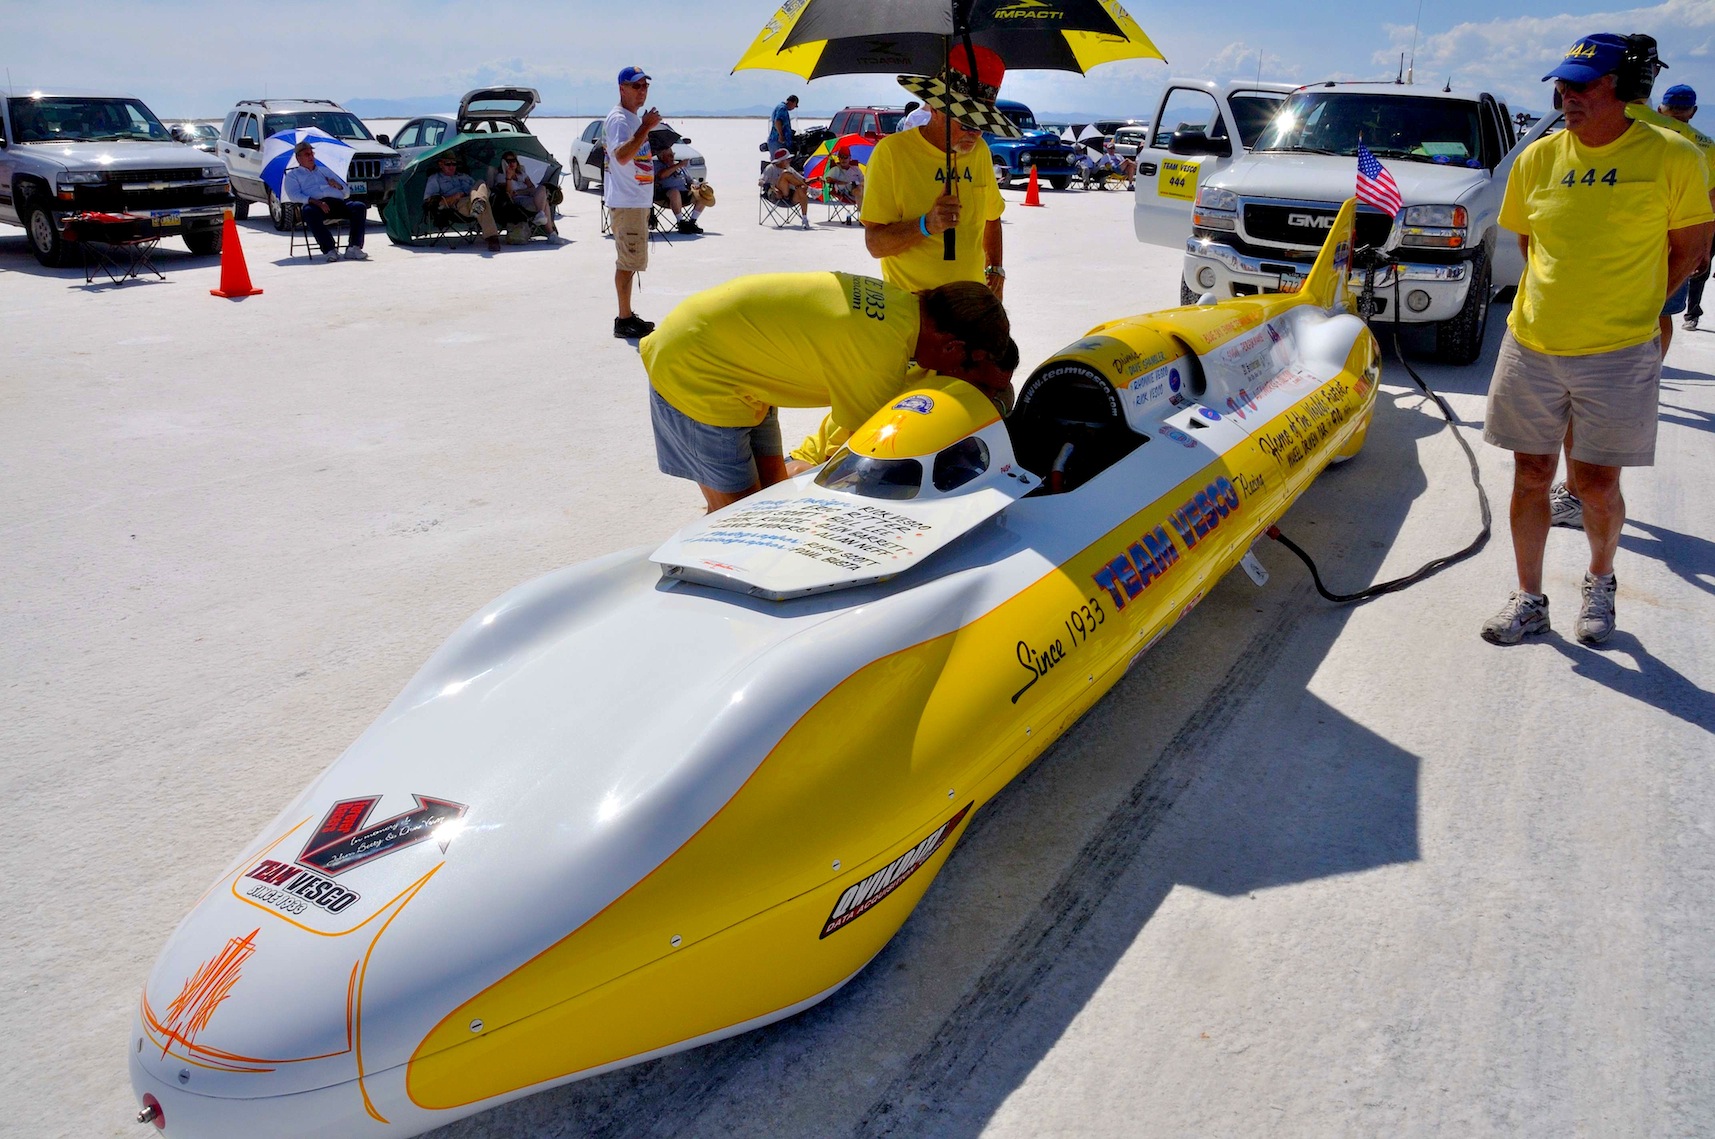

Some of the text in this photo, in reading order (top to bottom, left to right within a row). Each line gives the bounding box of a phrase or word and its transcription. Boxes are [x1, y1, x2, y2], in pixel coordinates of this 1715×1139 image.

[1565, 43, 1597, 59] 444
[1163, 162, 1197, 173] TEAM VESCO
[1561, 168, 1618, 187] 444
[1169, 176, 1185, 187] 444
[1288, 213, 1336, 228] GMC
[1024, 366, 1118, 417] www.teamvesco.com
[1091, 473, 1268, 613] TEAM VESCO Racing
[840, 552, 881, 566] SCOTT
[1011, 597, 1105, 704] Since 1933
[245, 859, 360, 914] TEAM VESCO
[246, 884, 308, 915] SINCE 1933
[826, 910, 855, 933] DATA
